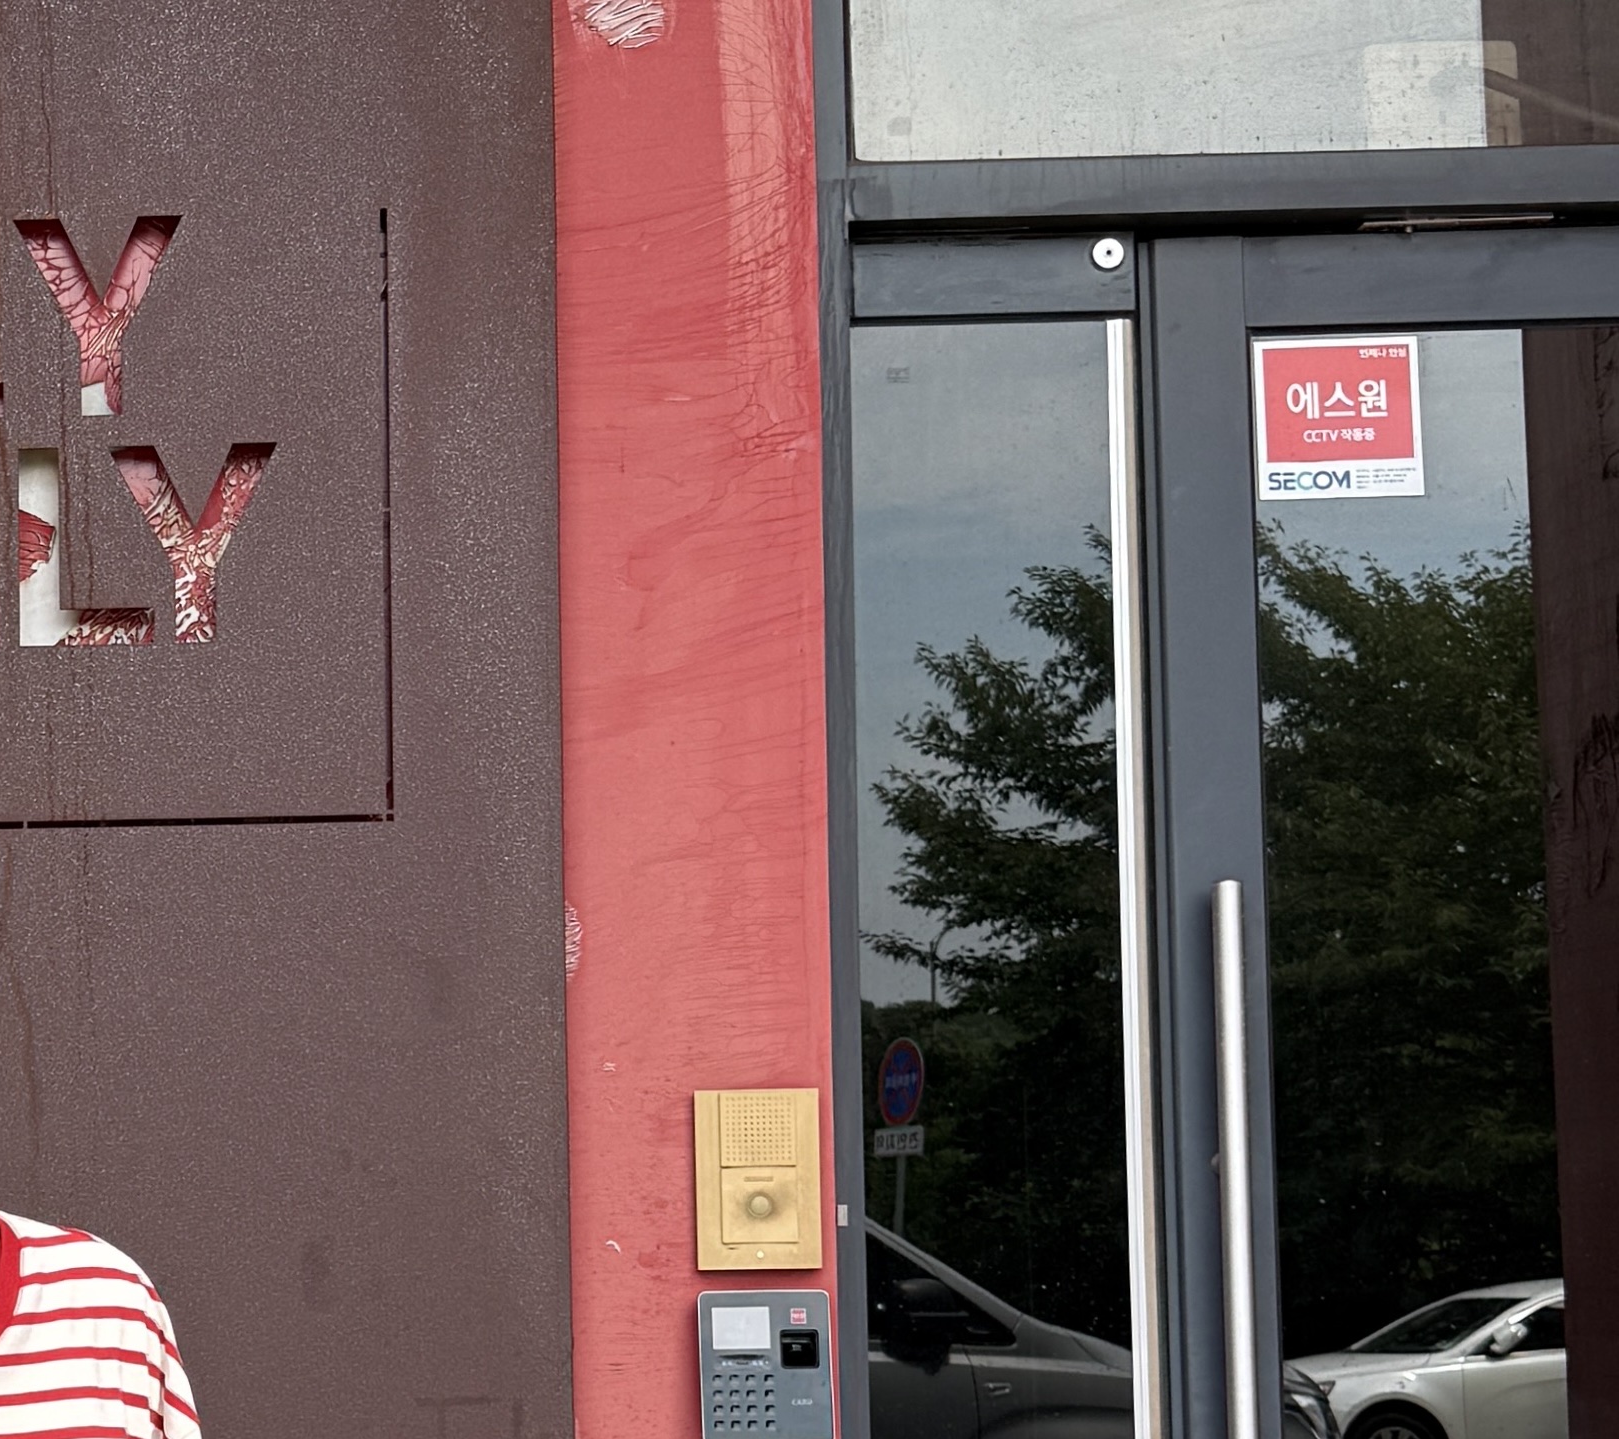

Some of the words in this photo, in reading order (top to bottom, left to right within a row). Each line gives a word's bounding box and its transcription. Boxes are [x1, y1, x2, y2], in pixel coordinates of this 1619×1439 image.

[1286, 379, 1388, 419] 에스원
[1303, 429, 1339, 443] CCTV
[1268, 470, 1351, 491] SECOM
